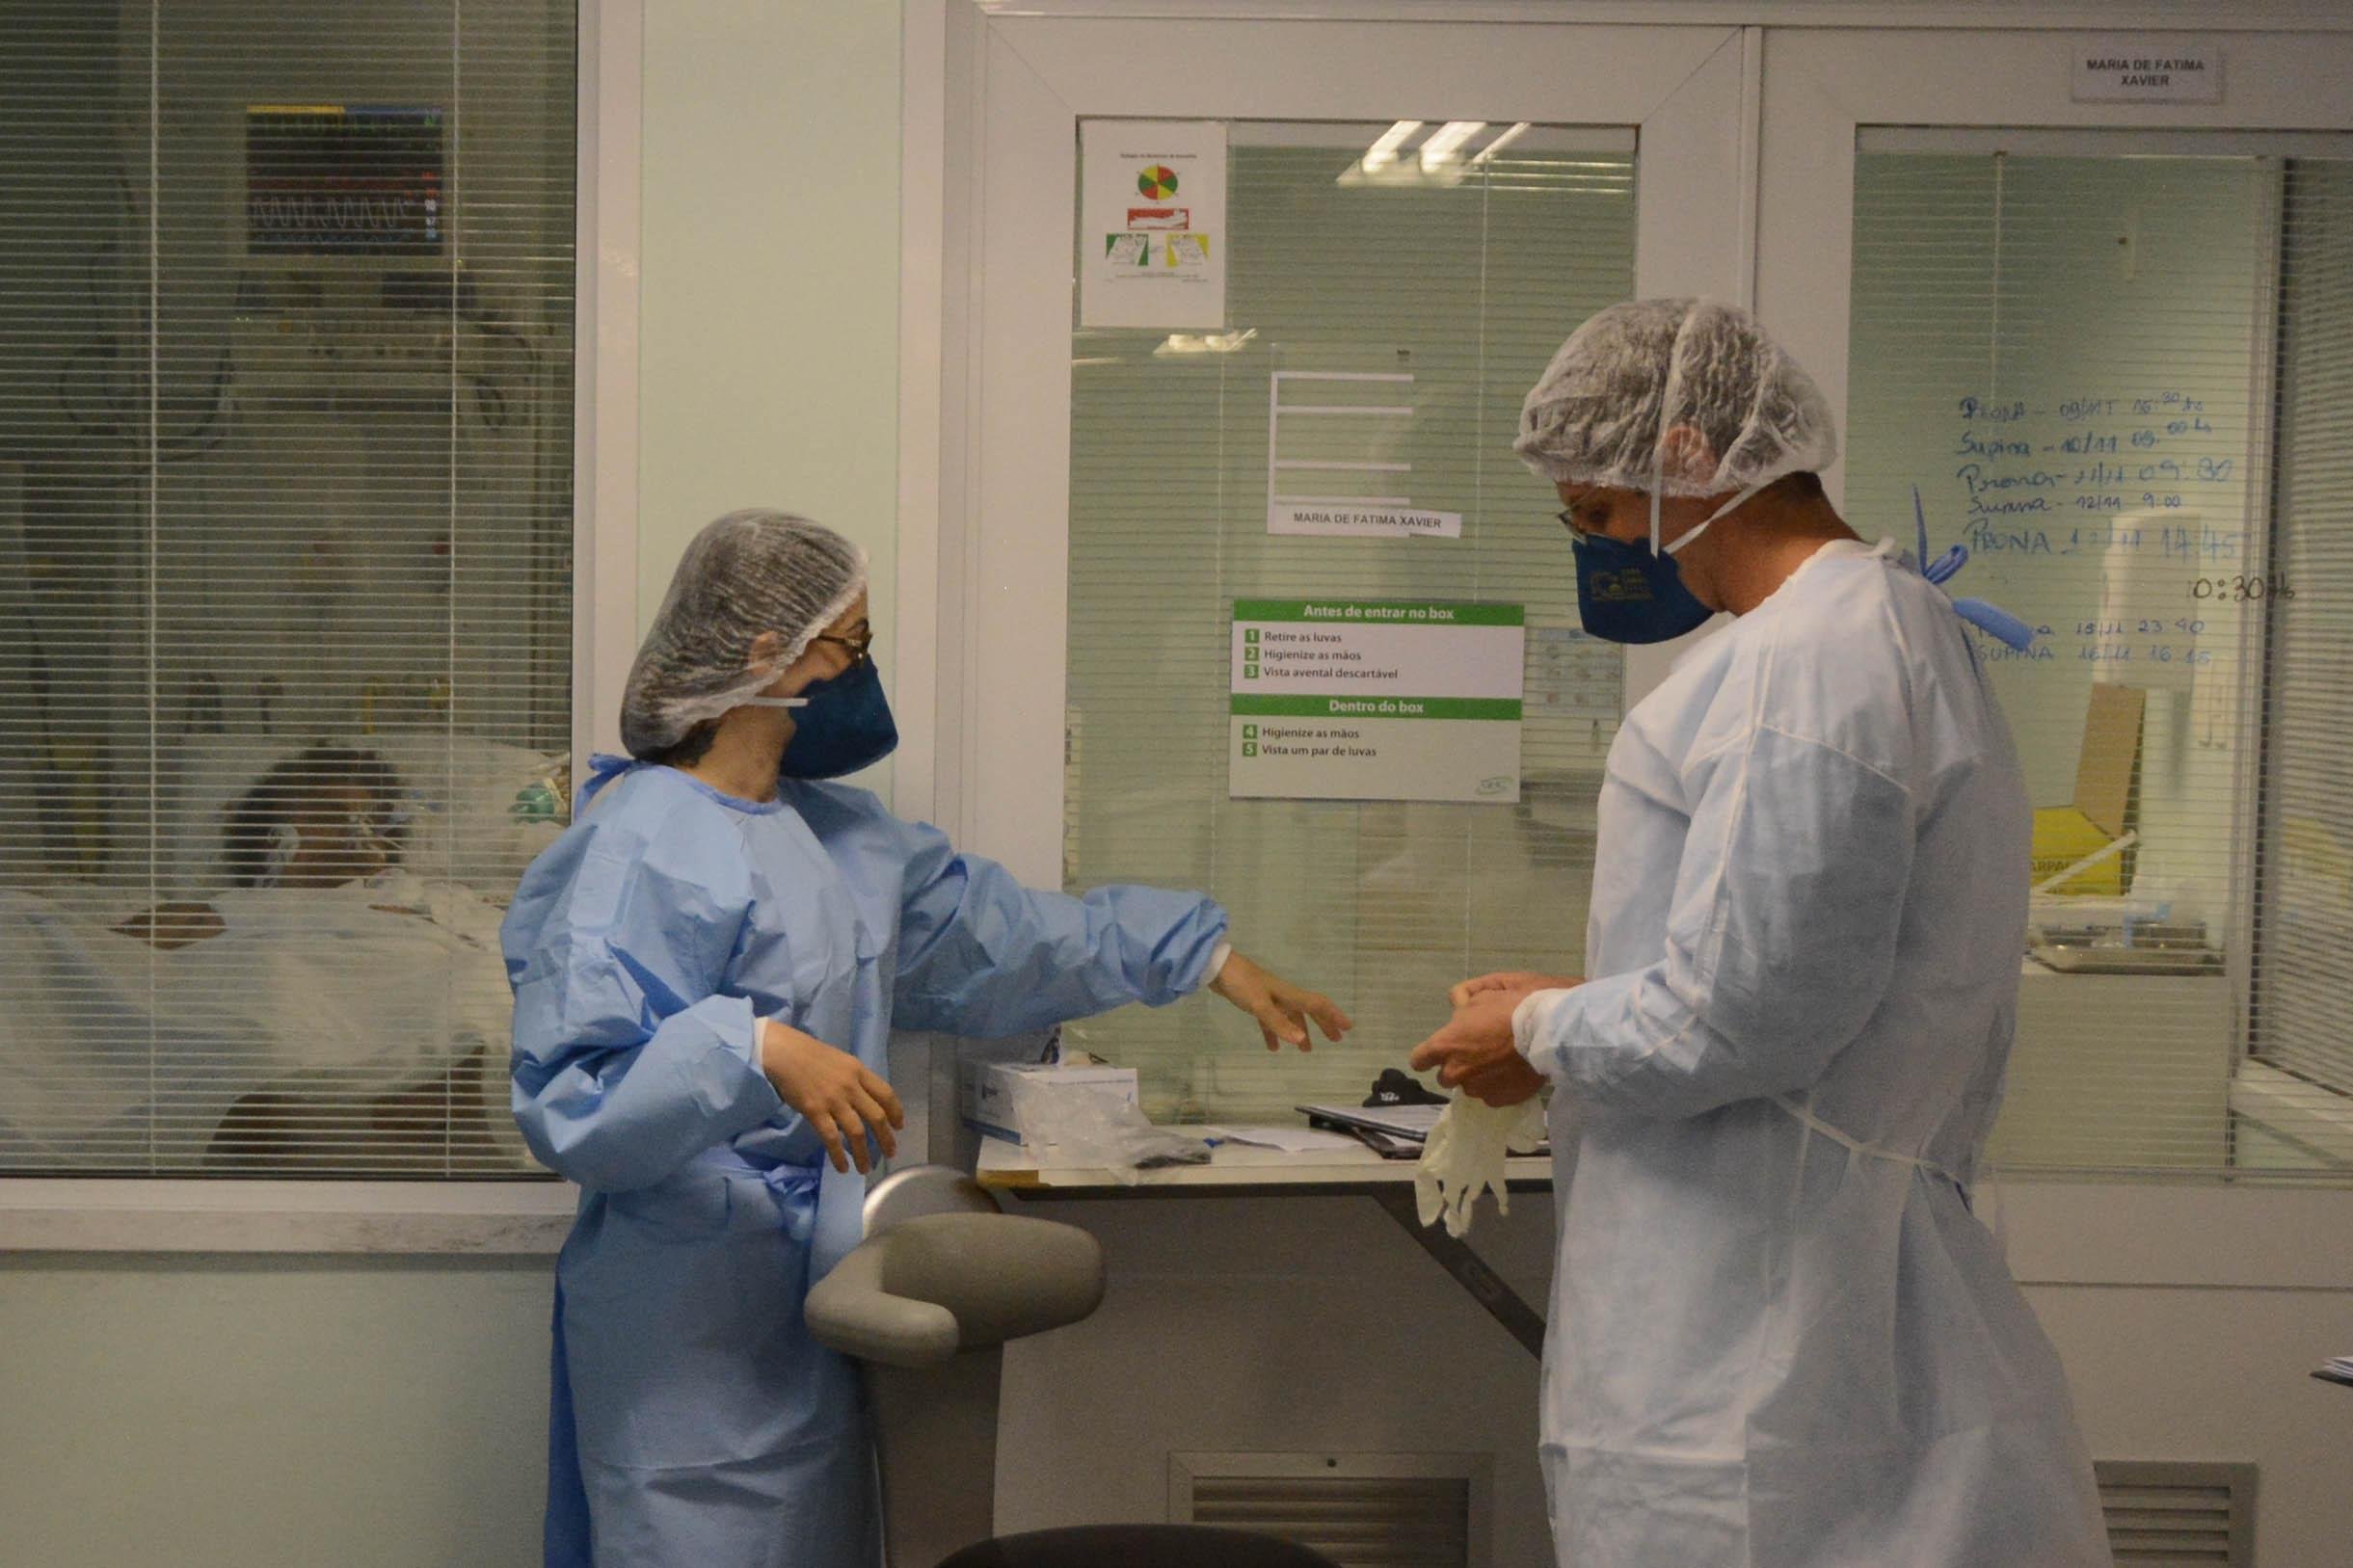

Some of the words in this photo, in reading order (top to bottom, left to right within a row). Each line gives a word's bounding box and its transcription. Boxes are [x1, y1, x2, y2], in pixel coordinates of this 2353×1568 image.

[2086, 59, 2129, 70] MARIA
[2133, 59, 2151, 70] DE
[2154, 59, 2206, 70] FATIMA
[2121, 75, 2170, 86] XAVIER
[1294, 513, 1331, 523] MARIA
[1334, 514, 1350, 524] DE
[1353, 514, 1397, 526] FATIMA
[1399, 516, 1442, 529] XAVIER
[1303, 605, 1345, 619] Antes
[1348, 605, 1363, 618] de
[1365, 607, 1405, 619] entrar
[1407, 607, 1427, 619] no
[1429, 606, 1455, 620] box
[1265, 631, 1297, 644] Retire
[1300, 633, 1311, 644] as
[1313, 631, 1342, 644] luvas
[1264, 650, 1315, 662] Higienize
[1318, 651, 1329, 661] as
[1331, 650, 1361, 662] mãos
[1264, 667, 1290, 678] Vista
[1293, 667, 1333, 678] avental
[1335, 666, 1399, 680] descartável
[1329, 700, 1376, 713] Dentro
[1378, 700, 1396, 713] do
[1399, 701, 1424, 713] box
[1262, 728, 1314, 740] Higienize
[1316, 730, 1327, 739] as
[1329, 728, 1360, 740] mãos
[1262, 745, 1289, 757] Vista
[1291, 746, 1309, 757] um
[1311, 746, 1328, 758] par
[1331, 746, 1346, 757] de
[1348, 746, 1377, 757] luvas
